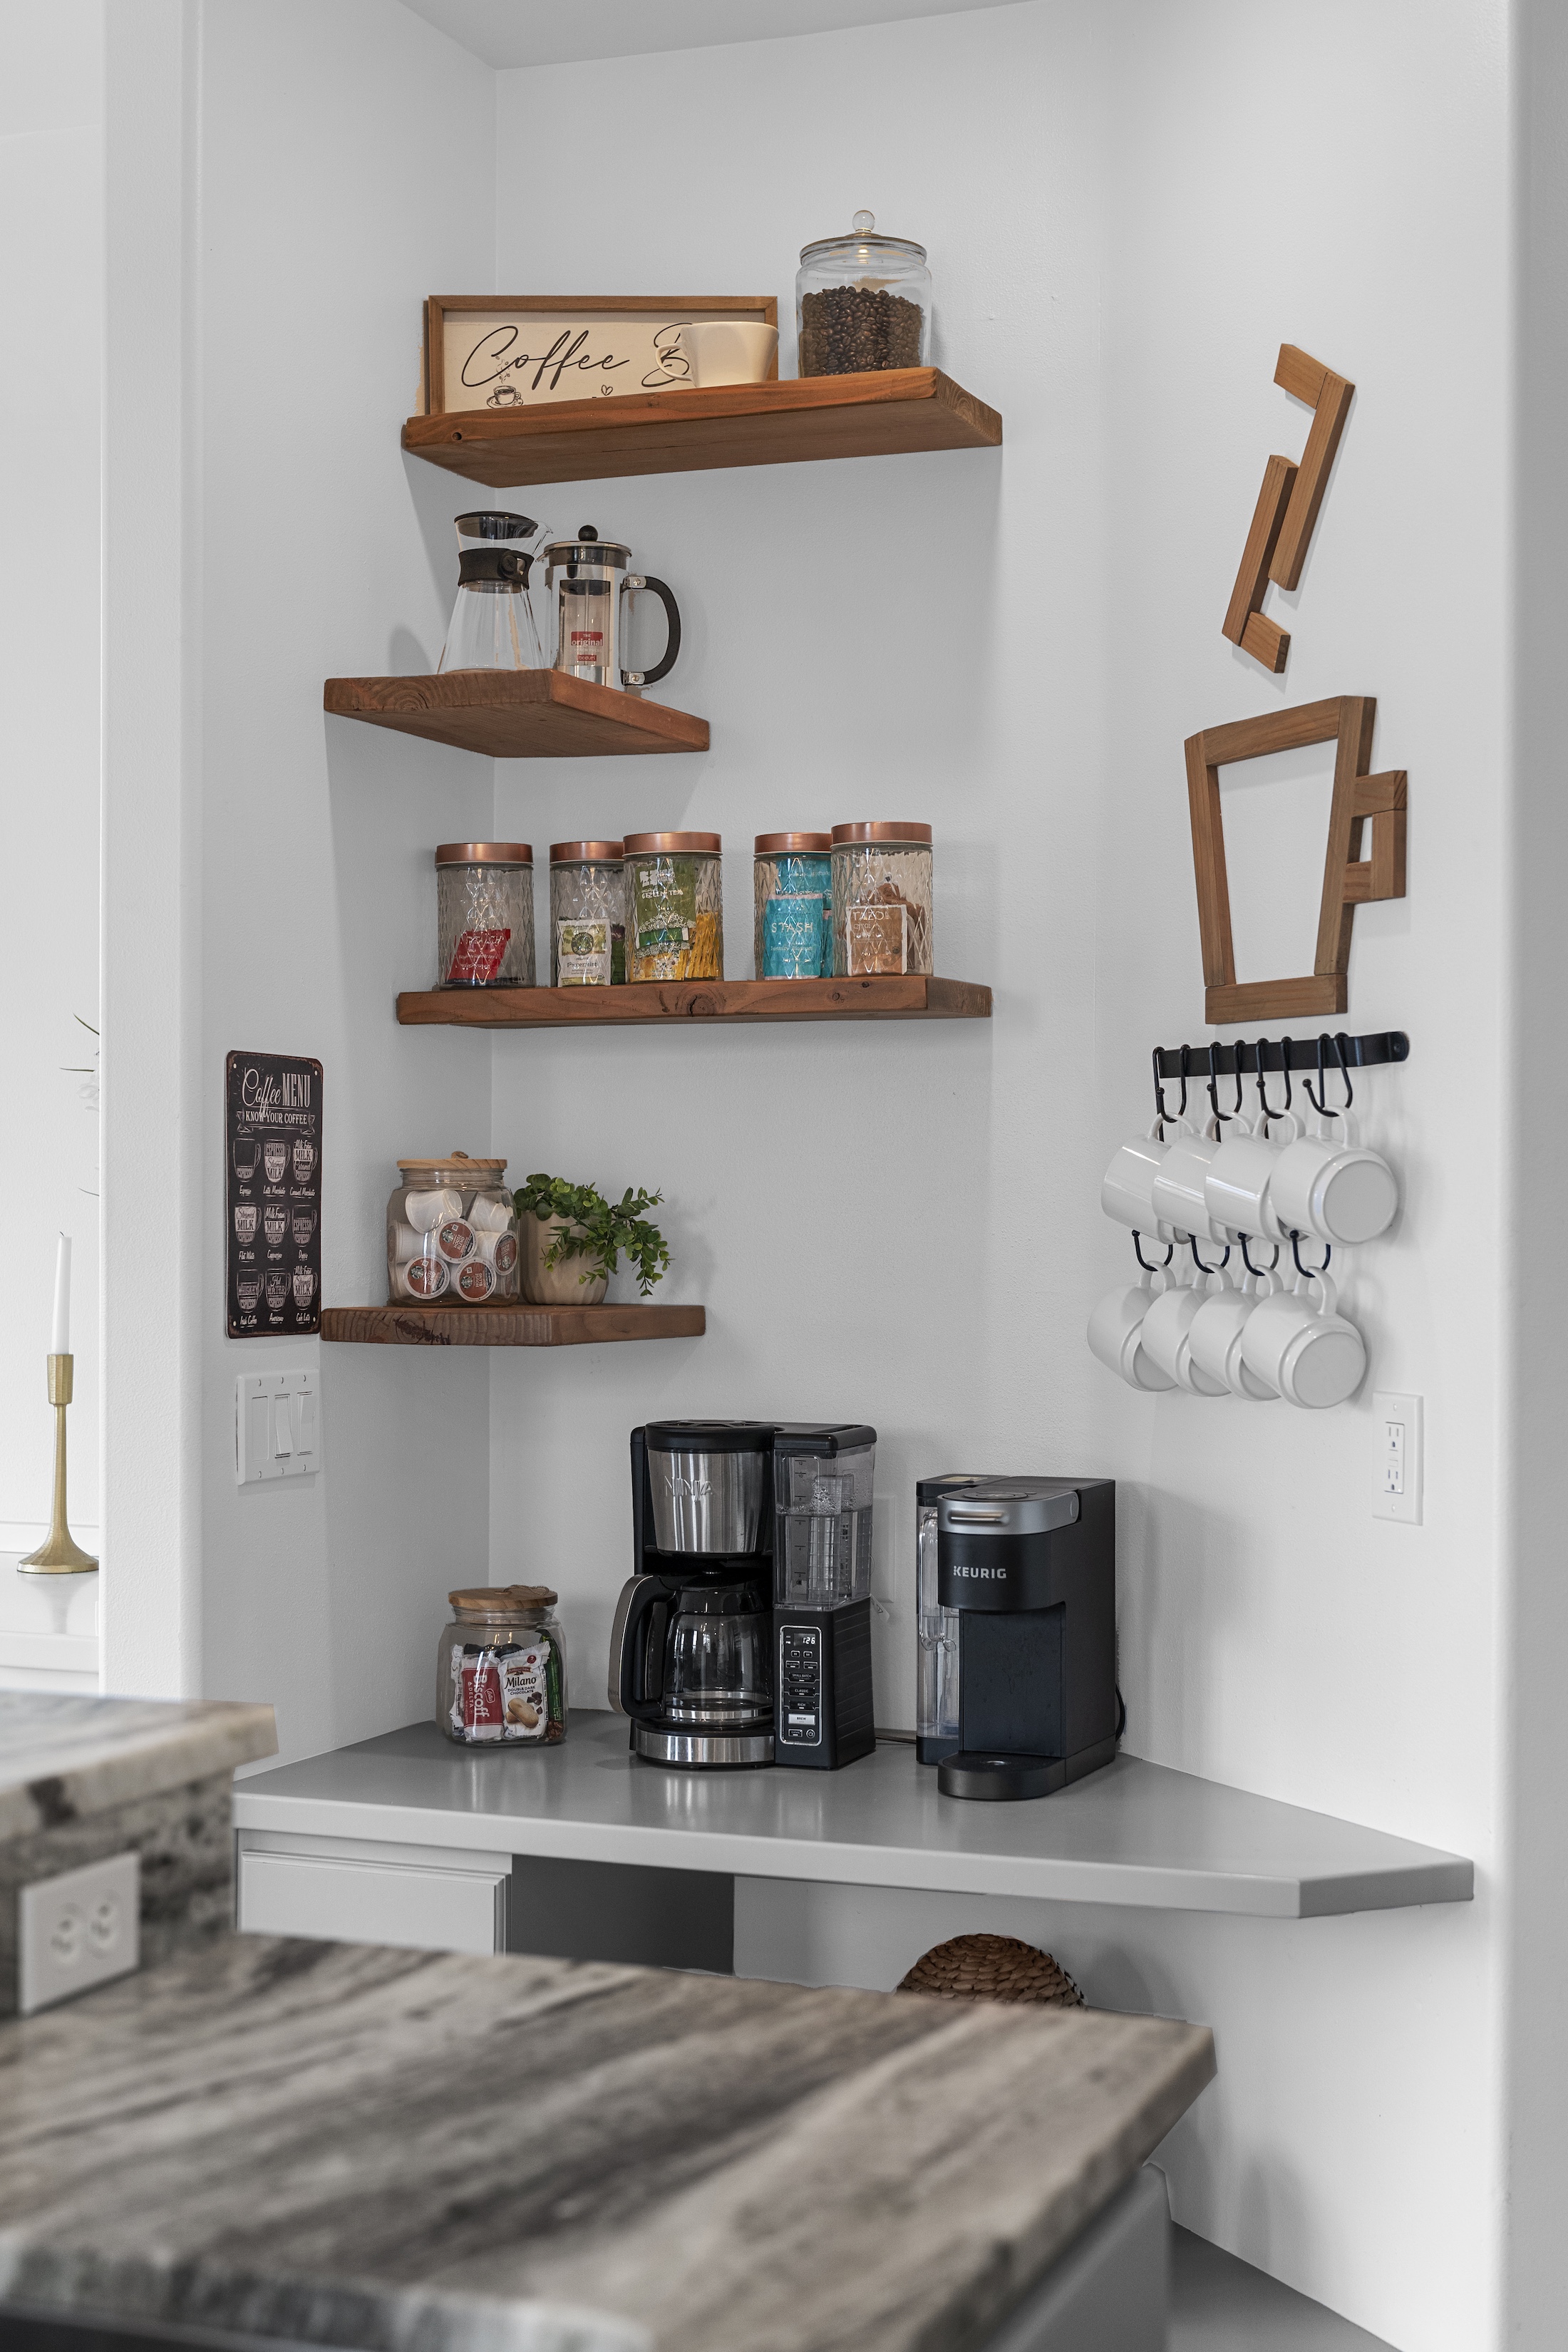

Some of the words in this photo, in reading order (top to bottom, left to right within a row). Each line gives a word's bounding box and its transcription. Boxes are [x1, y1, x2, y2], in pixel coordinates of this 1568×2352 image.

[462, 326, 630, 390] Coffee
[572, 639, 603, 647] original
[771, 922, 813, 934] STASH
[242, 1067, 282, 1118] Coffee
[282, 1073, 311, 1108] MENU
[246, 1110, 264, 1123] KNOW
[265, 1110, 283, 1123] YOUR
[284, 1113, 307, 1125] COFFEE
[295, 1149, 311, 1161] MILK
[267, 1168, 283, 1179] MILK
[266, 1207, 275, 1219] Milk
[237, 1219, 254, 1231] MILK
[267, 1222, 283, 1232] MILK
[453, 1234, 463, 1249] HOUSE
[295, 1285, 311, 1296] MILK
[664, 1475, 713, 1502] NINJA
[953, 1565, 1007, 1579] KEURIG
[803, 1636, 816, 1645] 1:26
[504, 1676, 537, 1690] Milano
[473, 1674, 490, 1718] Biscoff
